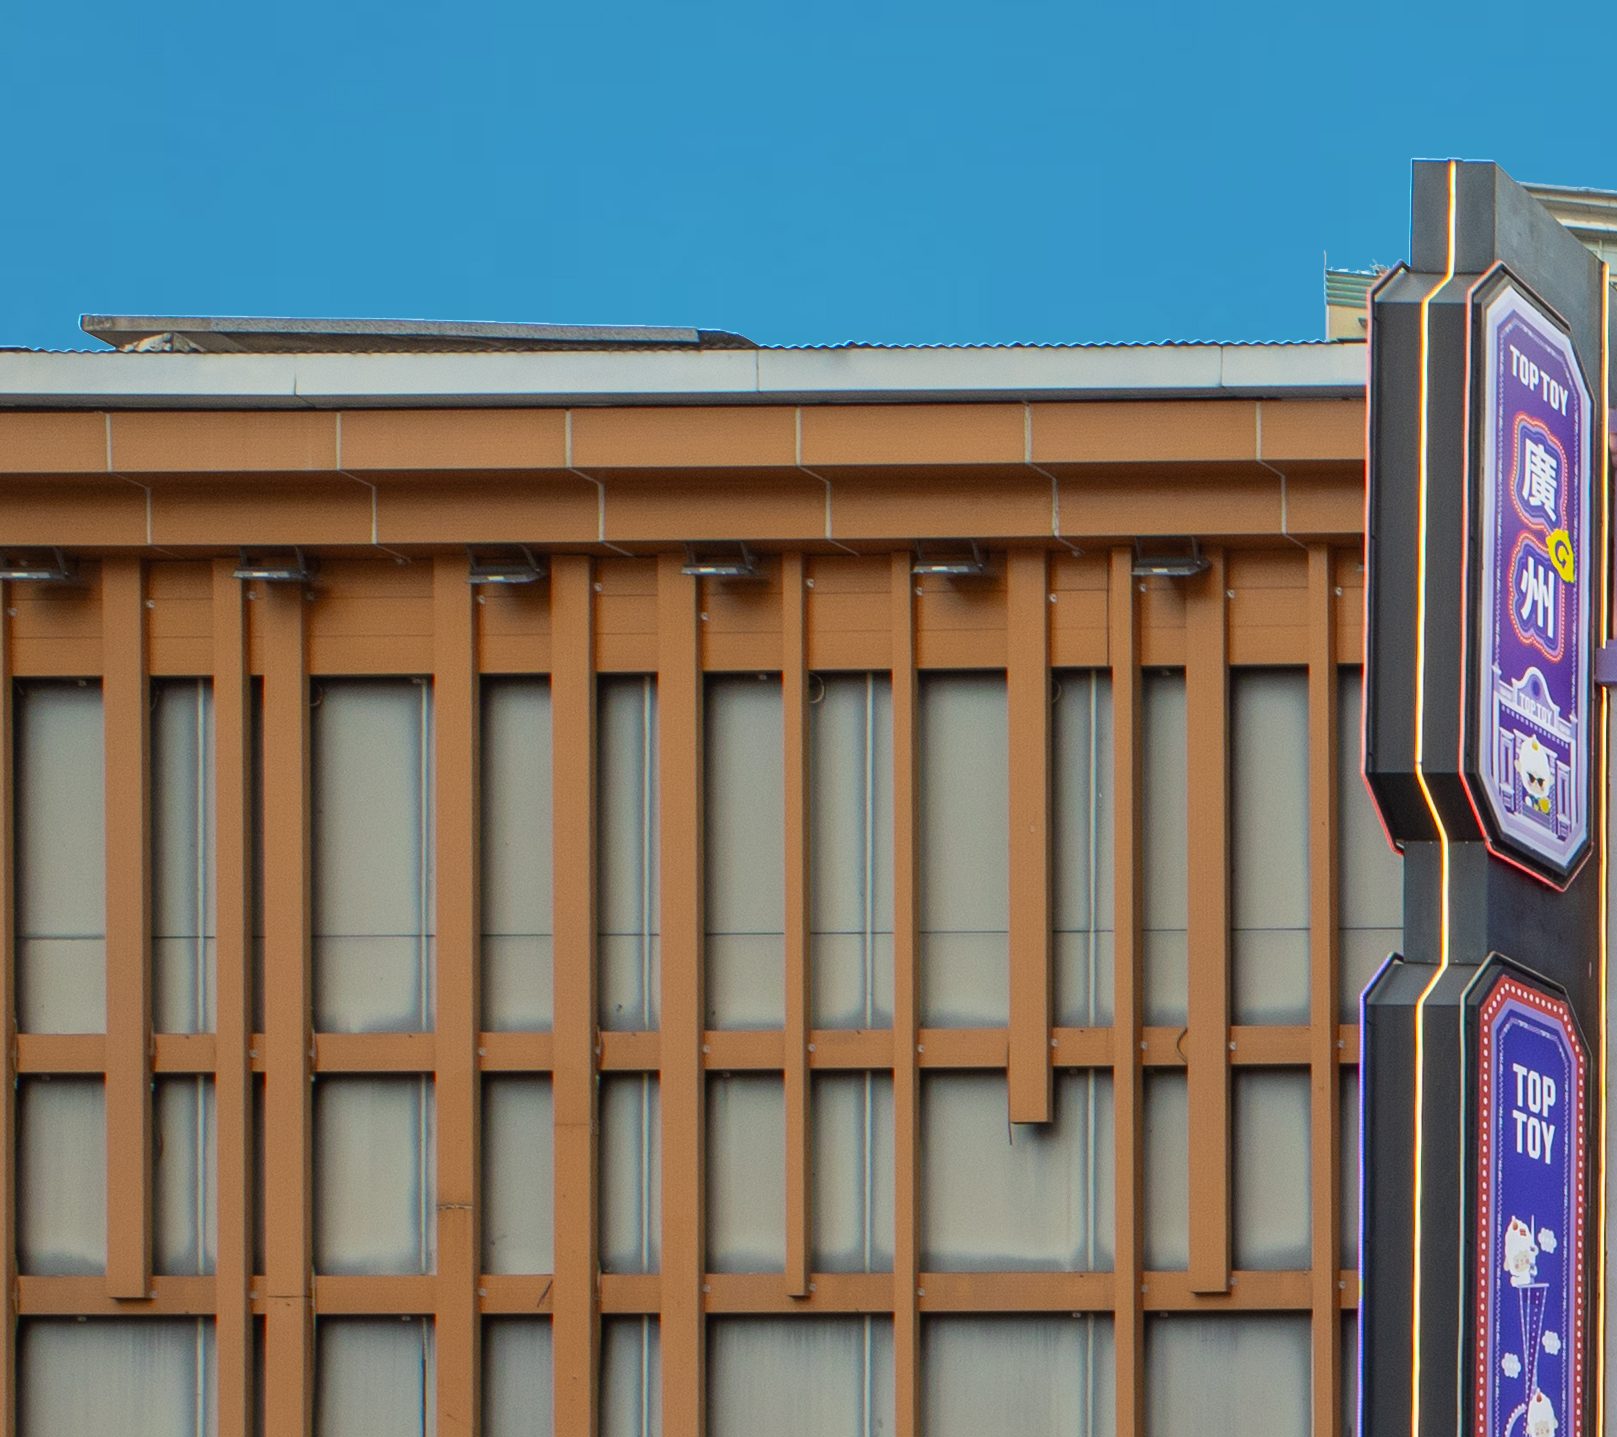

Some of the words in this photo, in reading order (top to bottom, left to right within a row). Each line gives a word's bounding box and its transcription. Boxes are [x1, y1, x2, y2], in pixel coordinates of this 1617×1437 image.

[1510, 345, 1539, 392] TOP
[1540, 370, 1568, 417] TOY
[1521, 438, 1557, 638] 廣州
[1513, 1063, 1556, 1109] TOP
[1513, 1110, 1555, 1165] TOY
